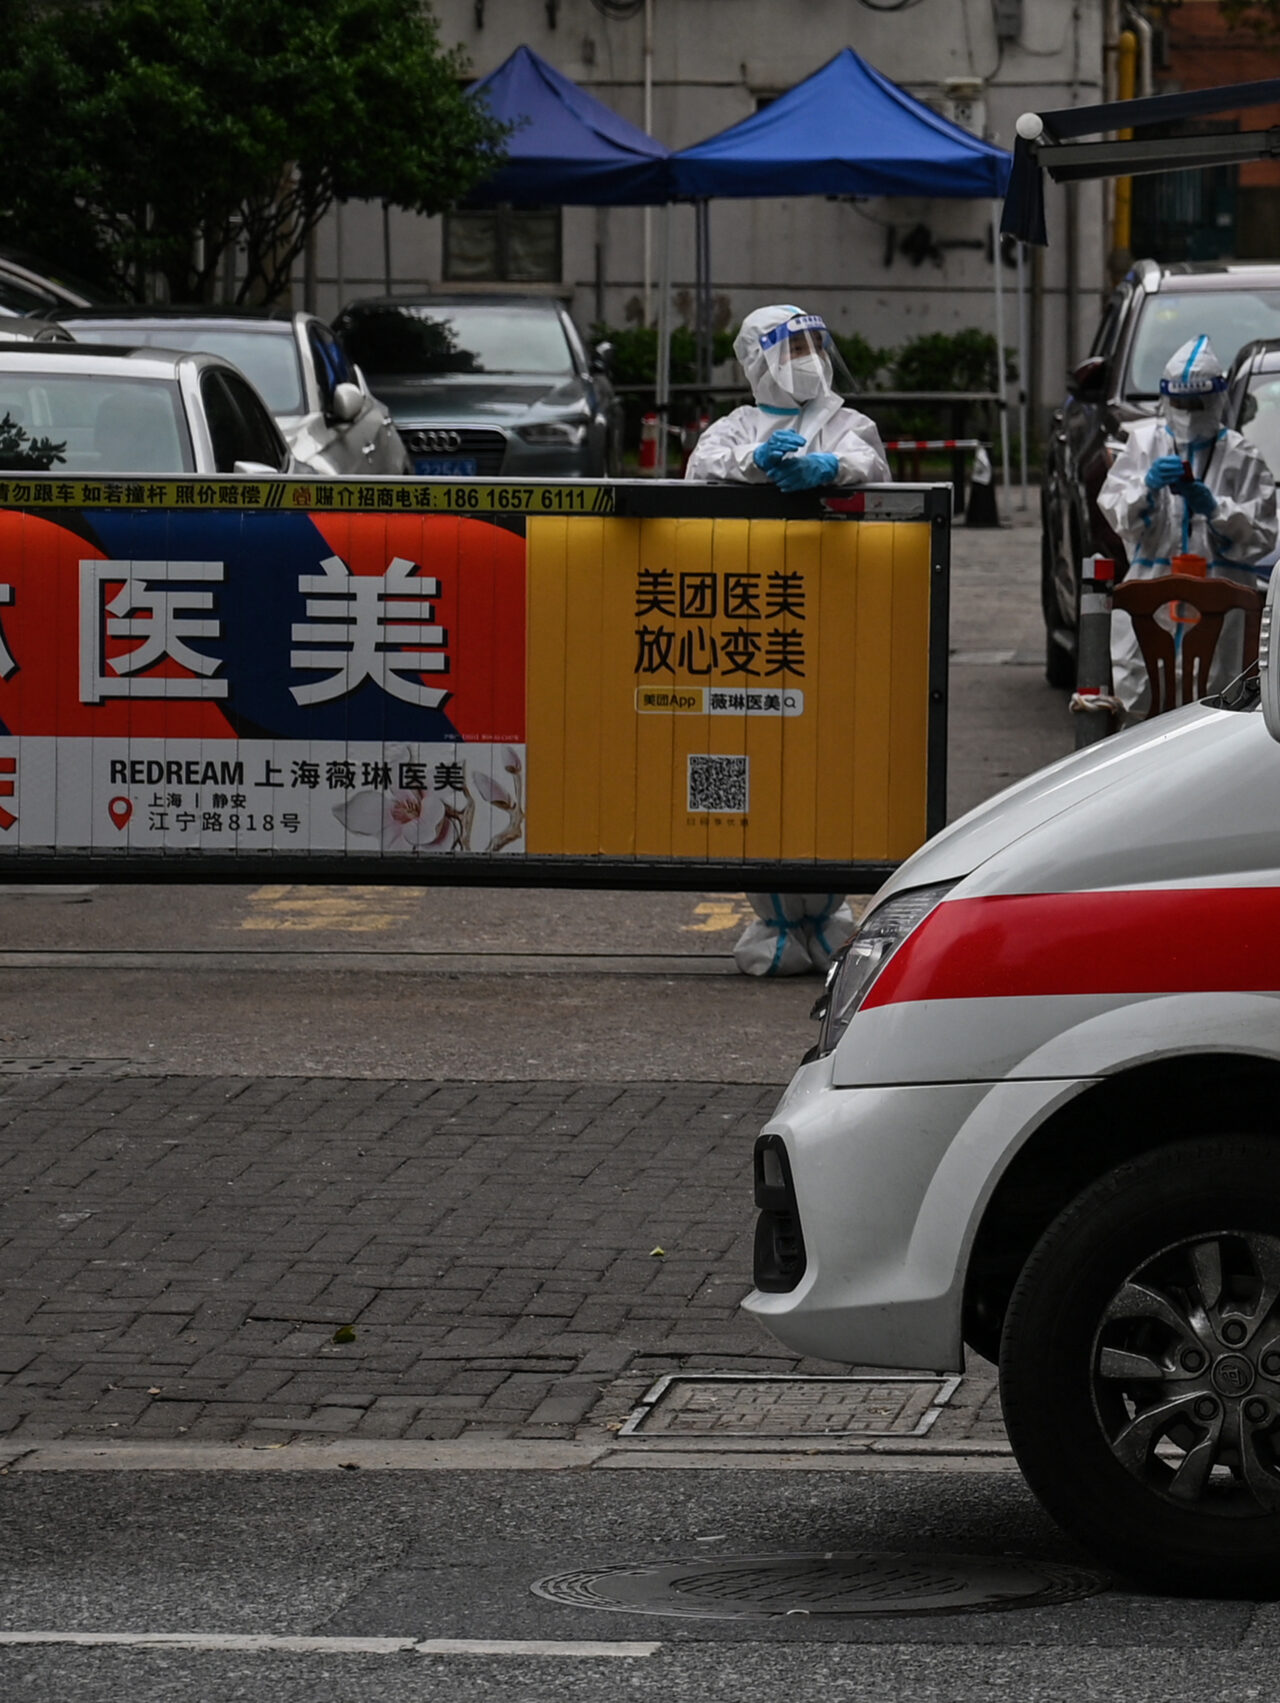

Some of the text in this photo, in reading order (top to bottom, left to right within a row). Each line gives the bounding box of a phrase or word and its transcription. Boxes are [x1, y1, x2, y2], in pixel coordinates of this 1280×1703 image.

[81, 484, 167, 503] 如若撞杆
[174, 485, 261, 504] 照价赔偿
[443, 488, 478, 509] 186
[486, 488, 532, 509] 1657
[540, 489, 585, 509] 6111
[634, 568, 806, 620] 美团医美
[634, 624, 806, 678] 放心变美
[710, 693, 781, 712] 薇琳医美
[110, 759, 465, 792] REDREAM 上海薇琳医美
[148, 792, 182, 809] 上海
[212, 793, 247, 809] 静安
[149, 811, 301, 834] 江宁路818号
